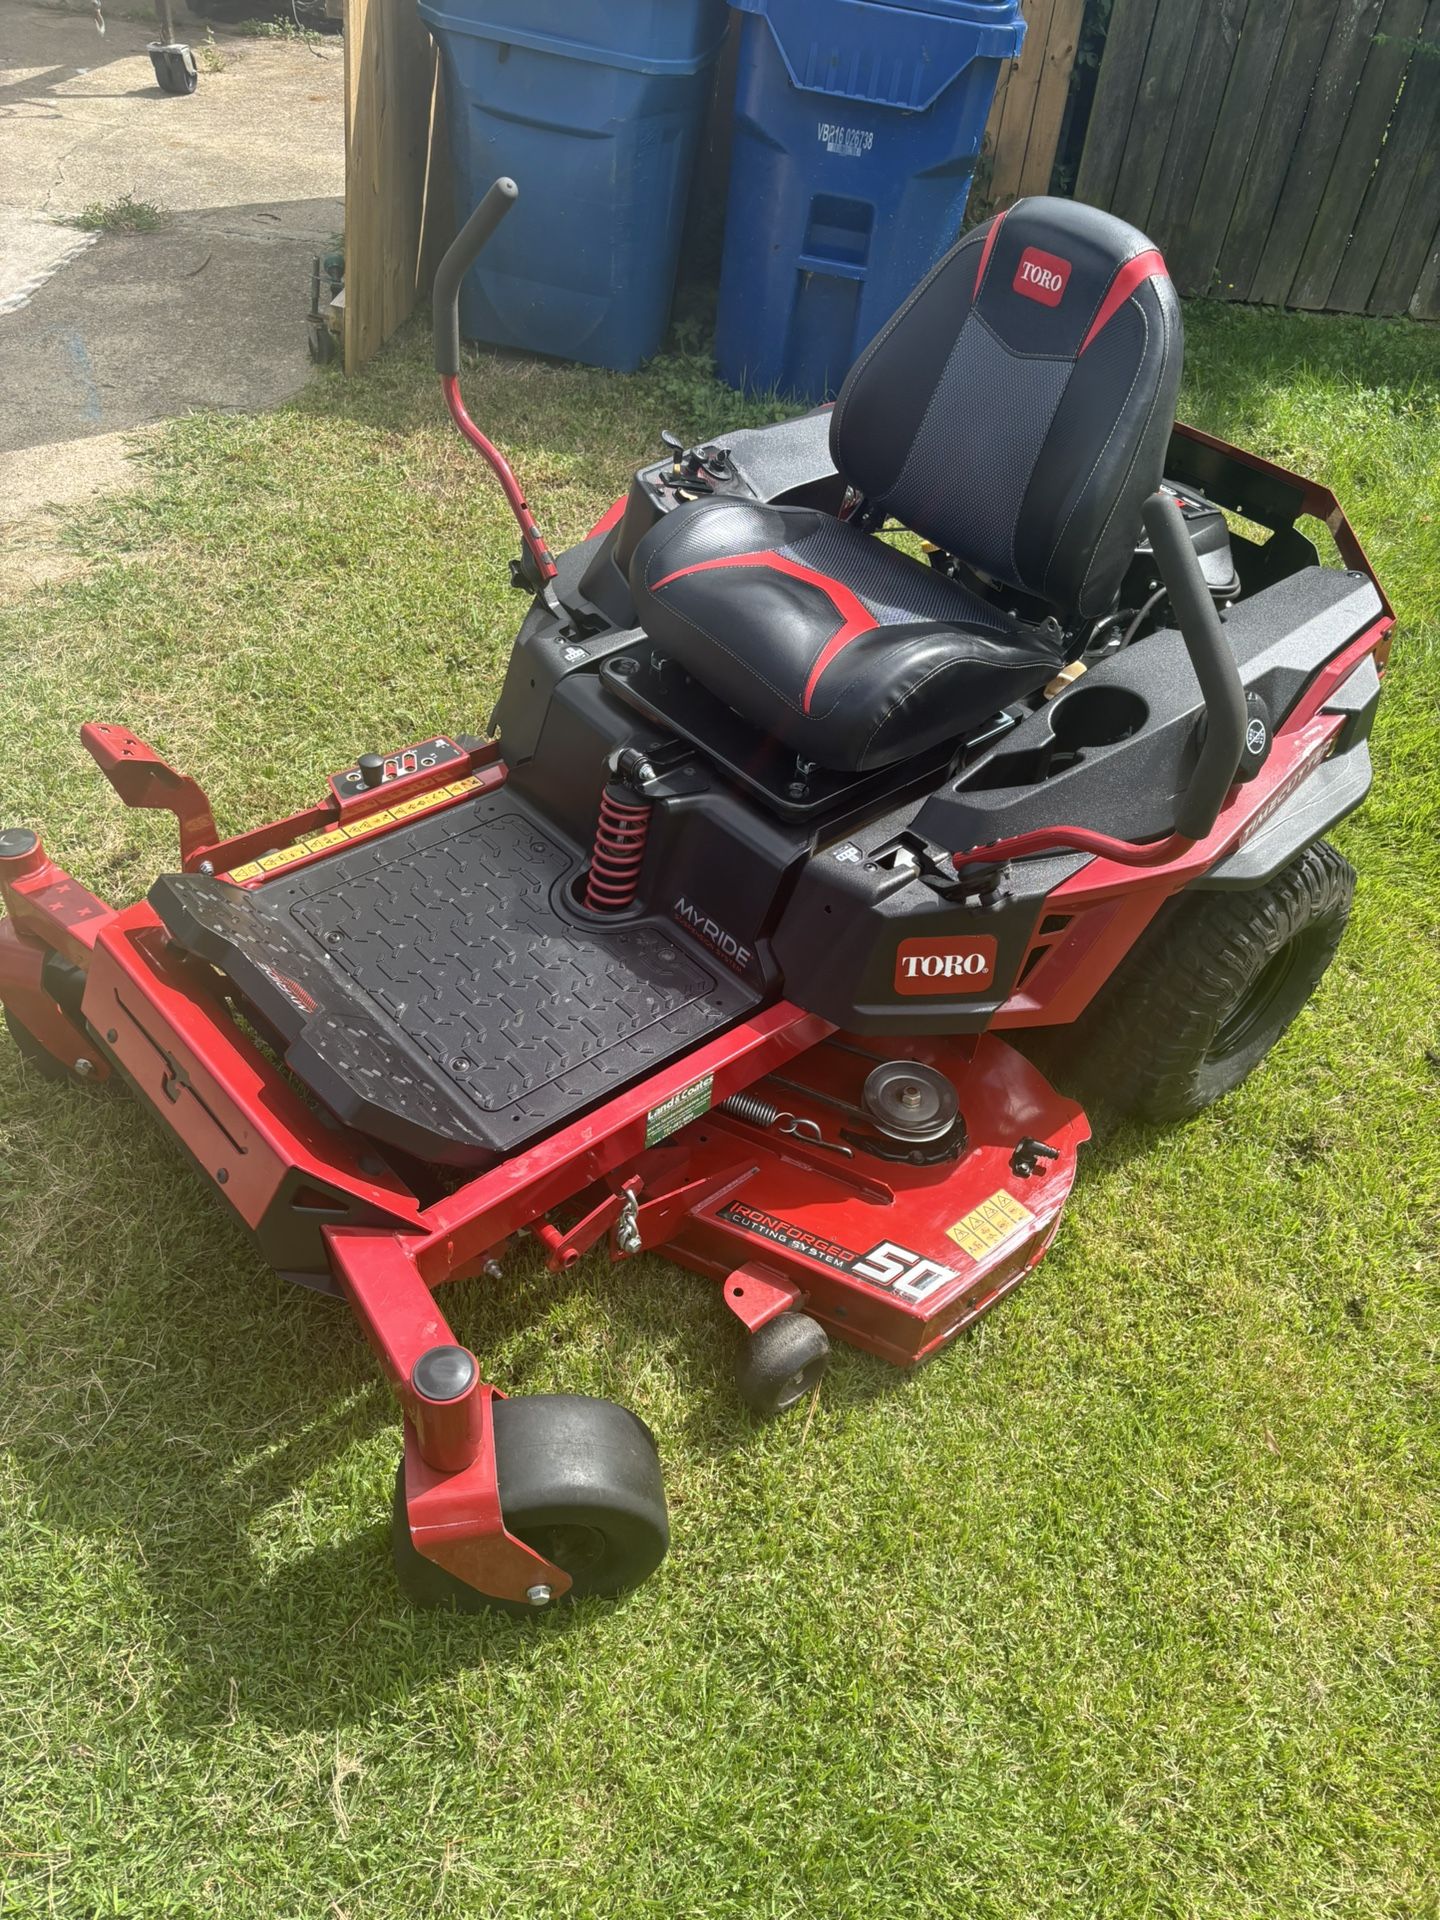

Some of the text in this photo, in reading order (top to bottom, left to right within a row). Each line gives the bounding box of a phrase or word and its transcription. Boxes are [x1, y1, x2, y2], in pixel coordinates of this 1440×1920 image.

[1021, 261, 1063, 291] TORO
[674, 897, 751, 969] MYRIDE
[730, 1202, 857, 1262] IRONFORGED
[732, 1214, 844, 1267] CUTTING SYSTEM
[851, 1242, 961, 1304] 50
